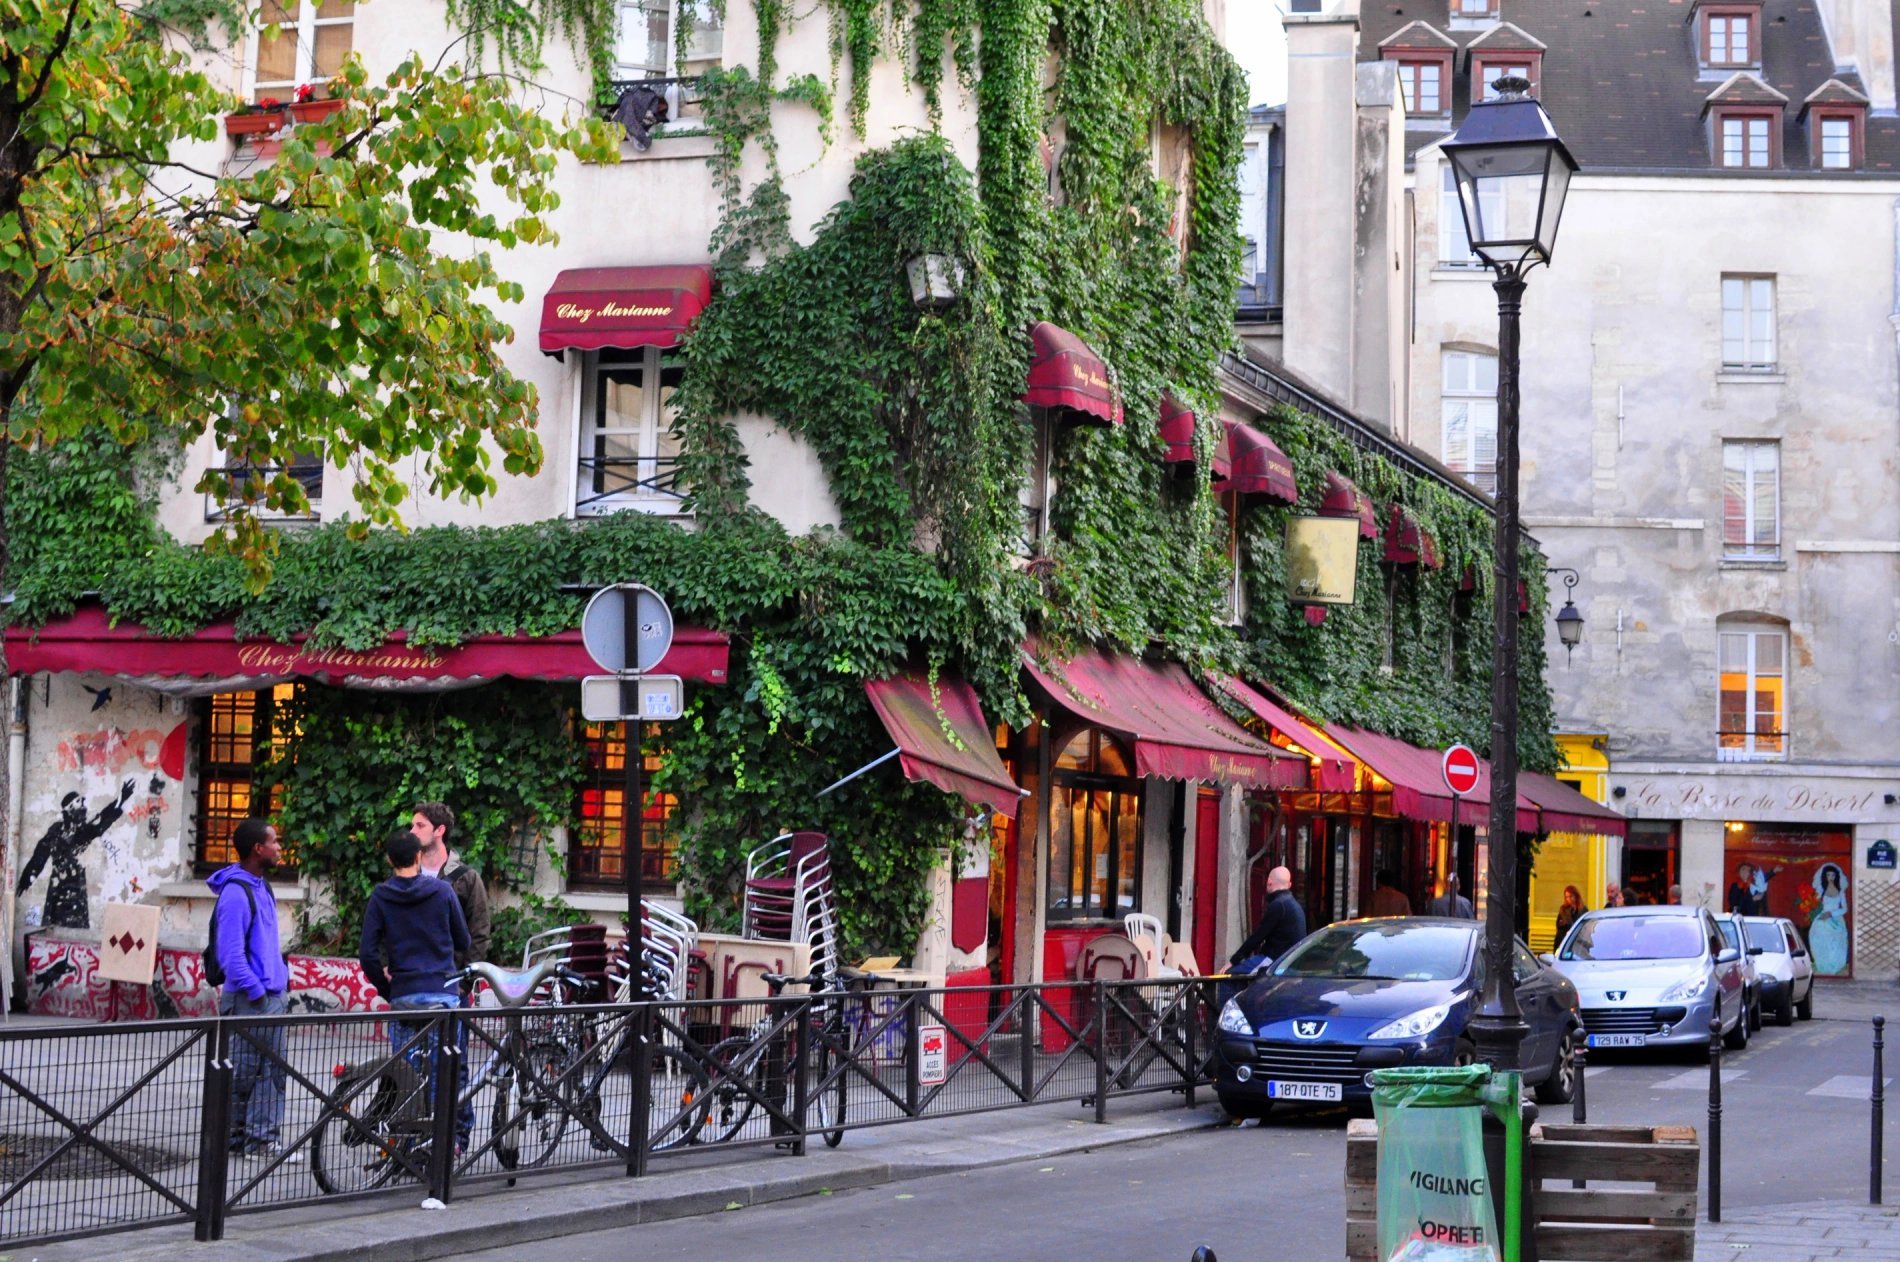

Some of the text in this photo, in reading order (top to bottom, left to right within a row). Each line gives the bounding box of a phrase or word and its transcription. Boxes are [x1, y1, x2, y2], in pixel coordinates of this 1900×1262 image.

[556, 301, 673, 324] Chez Marianne
[238, 645, 448, 675] Chez Marianne
[1627, 779, 1661, 809] La
[1670, 780, 1743, 807] Rose
[1751, 792, 1776, 810] du
[1632, 1035, 1643, 1045] 75
[1280, 1084, 1336, 1098] 187 QTE 75
